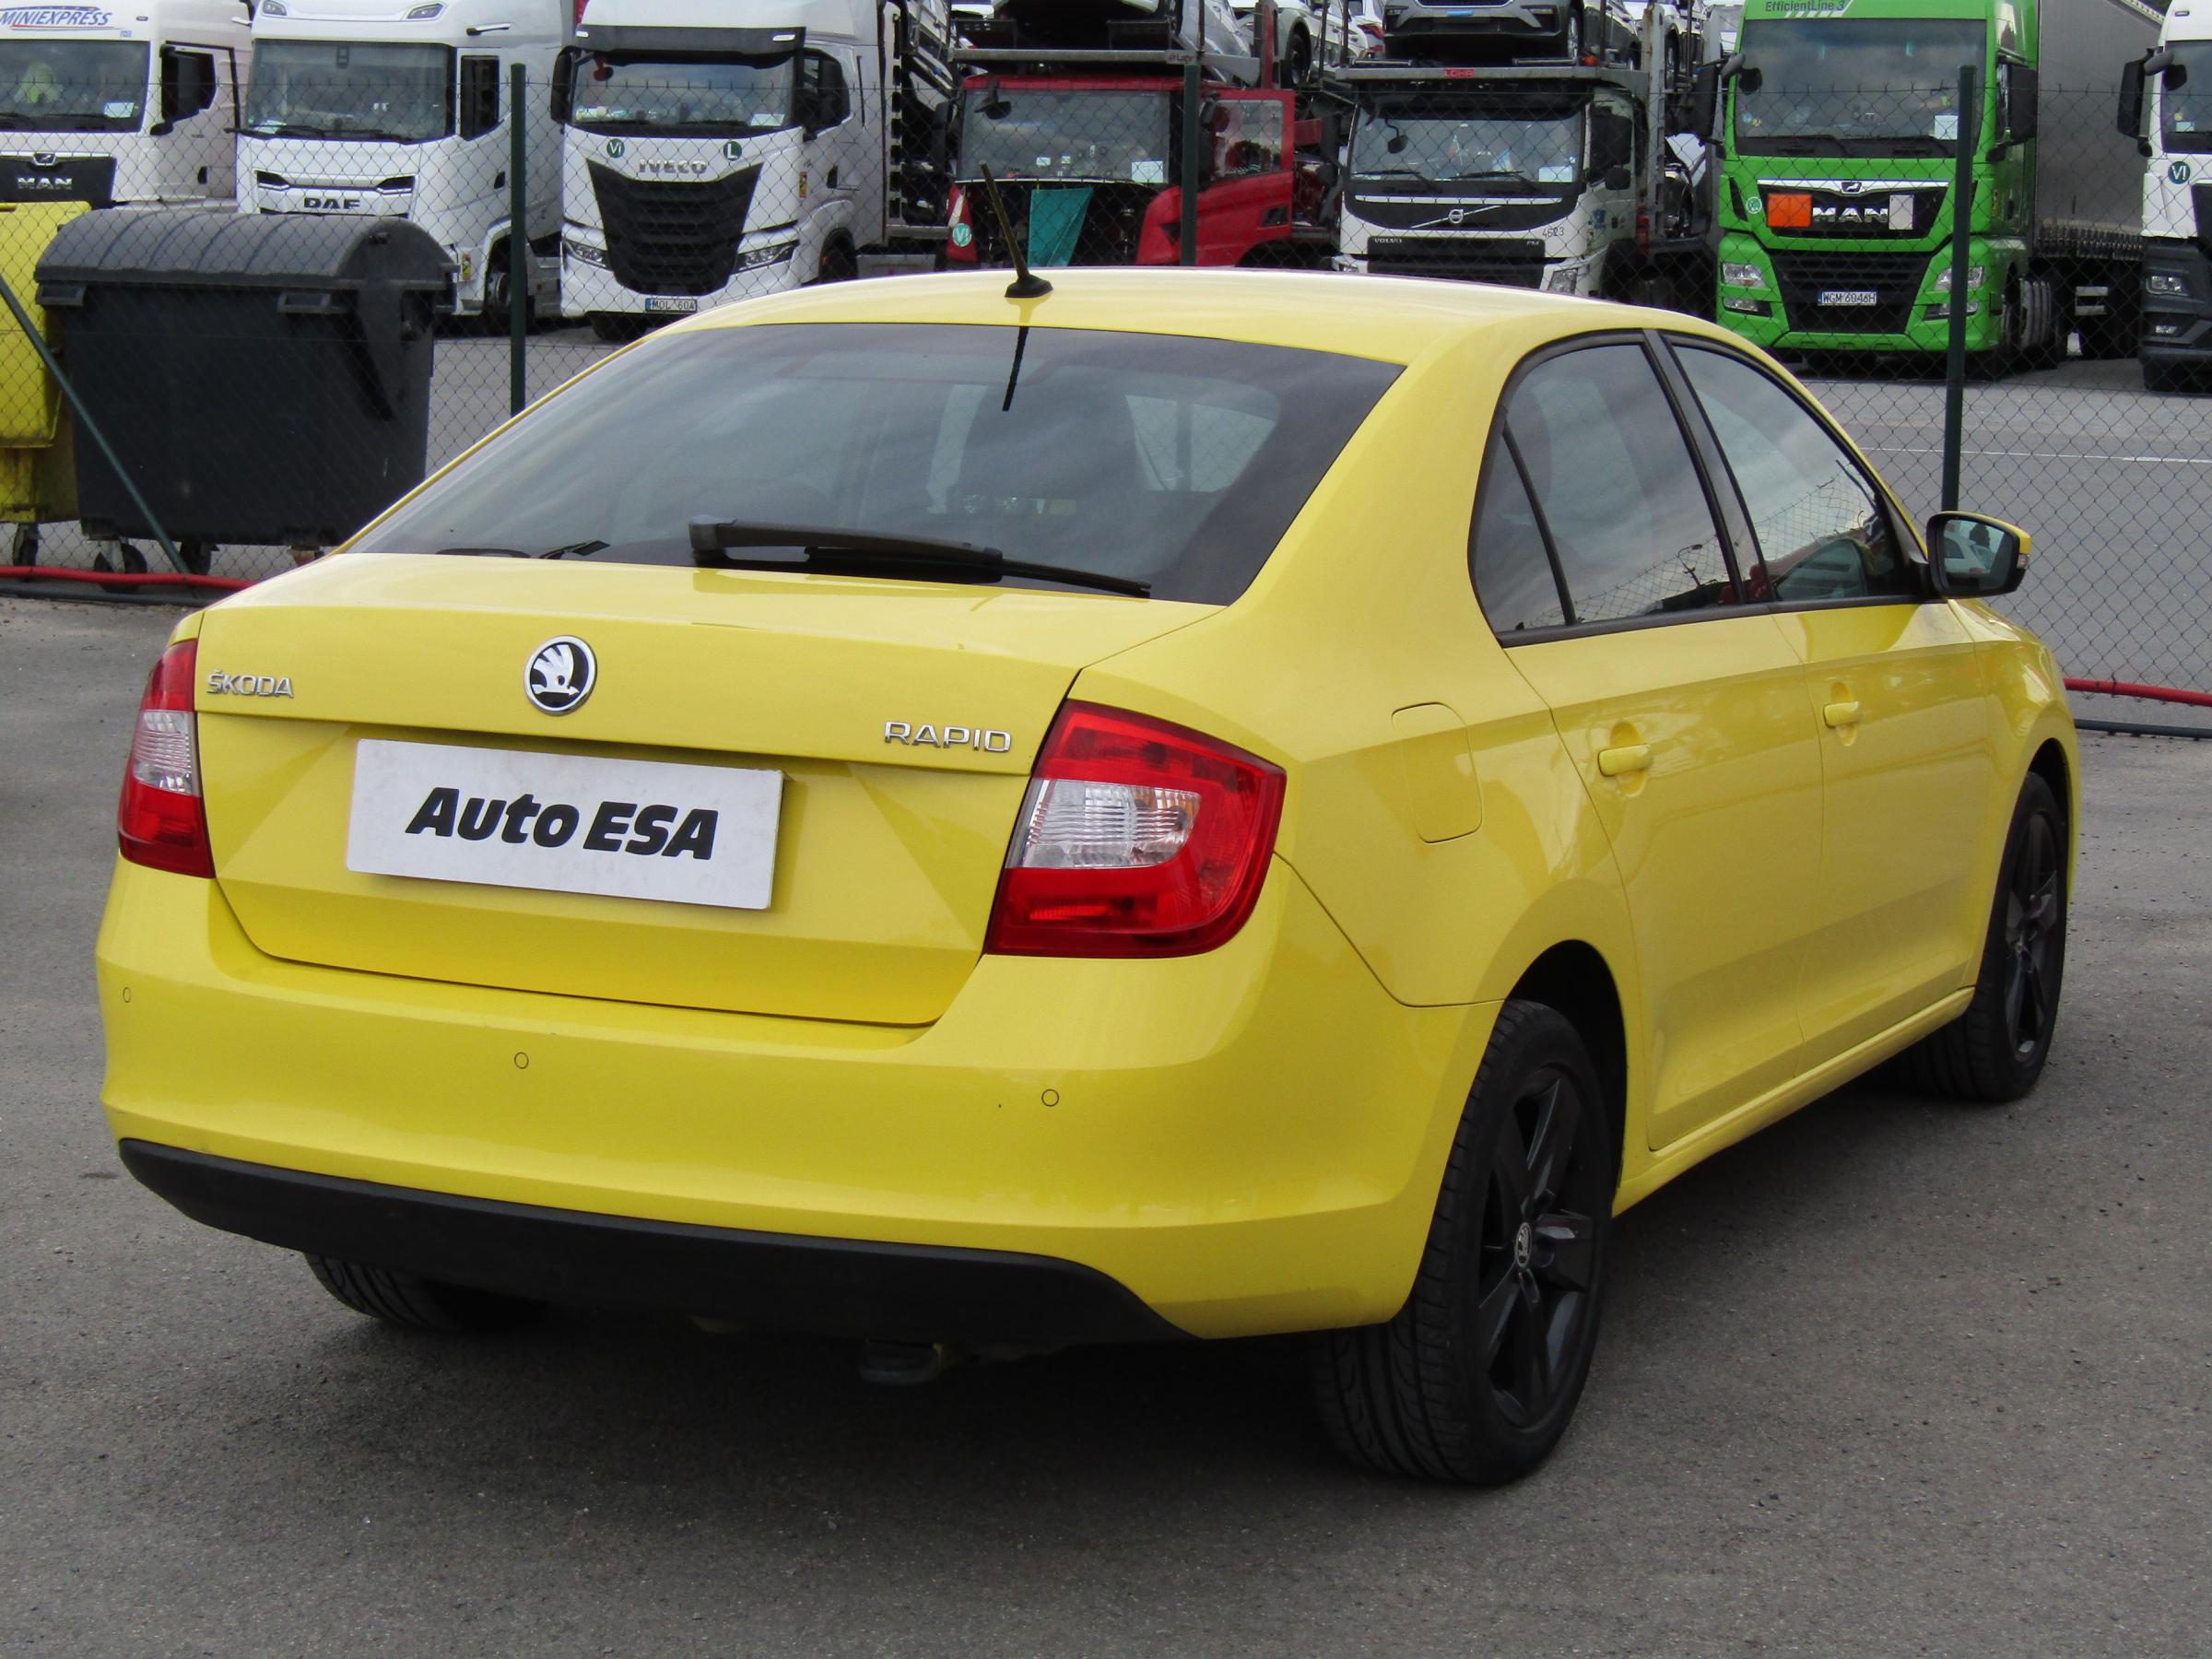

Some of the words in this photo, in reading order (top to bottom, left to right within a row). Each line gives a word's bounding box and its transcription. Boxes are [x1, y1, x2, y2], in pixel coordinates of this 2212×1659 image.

[0, 11, 112, 26] MINIEXPRESS
[639, 159, 708, 174] IVECO
[17, 176, 73, 190] MAN
[303, 197, 360, 210] DAF
[1812, 206, 1888, 223] MAN
[206, 669, 294, 698] ŠKODA
[885, 721, 1012, 753] RAPID
[406, 786, 580, 848] Auto
[582, 800, 719, 861] ESA
